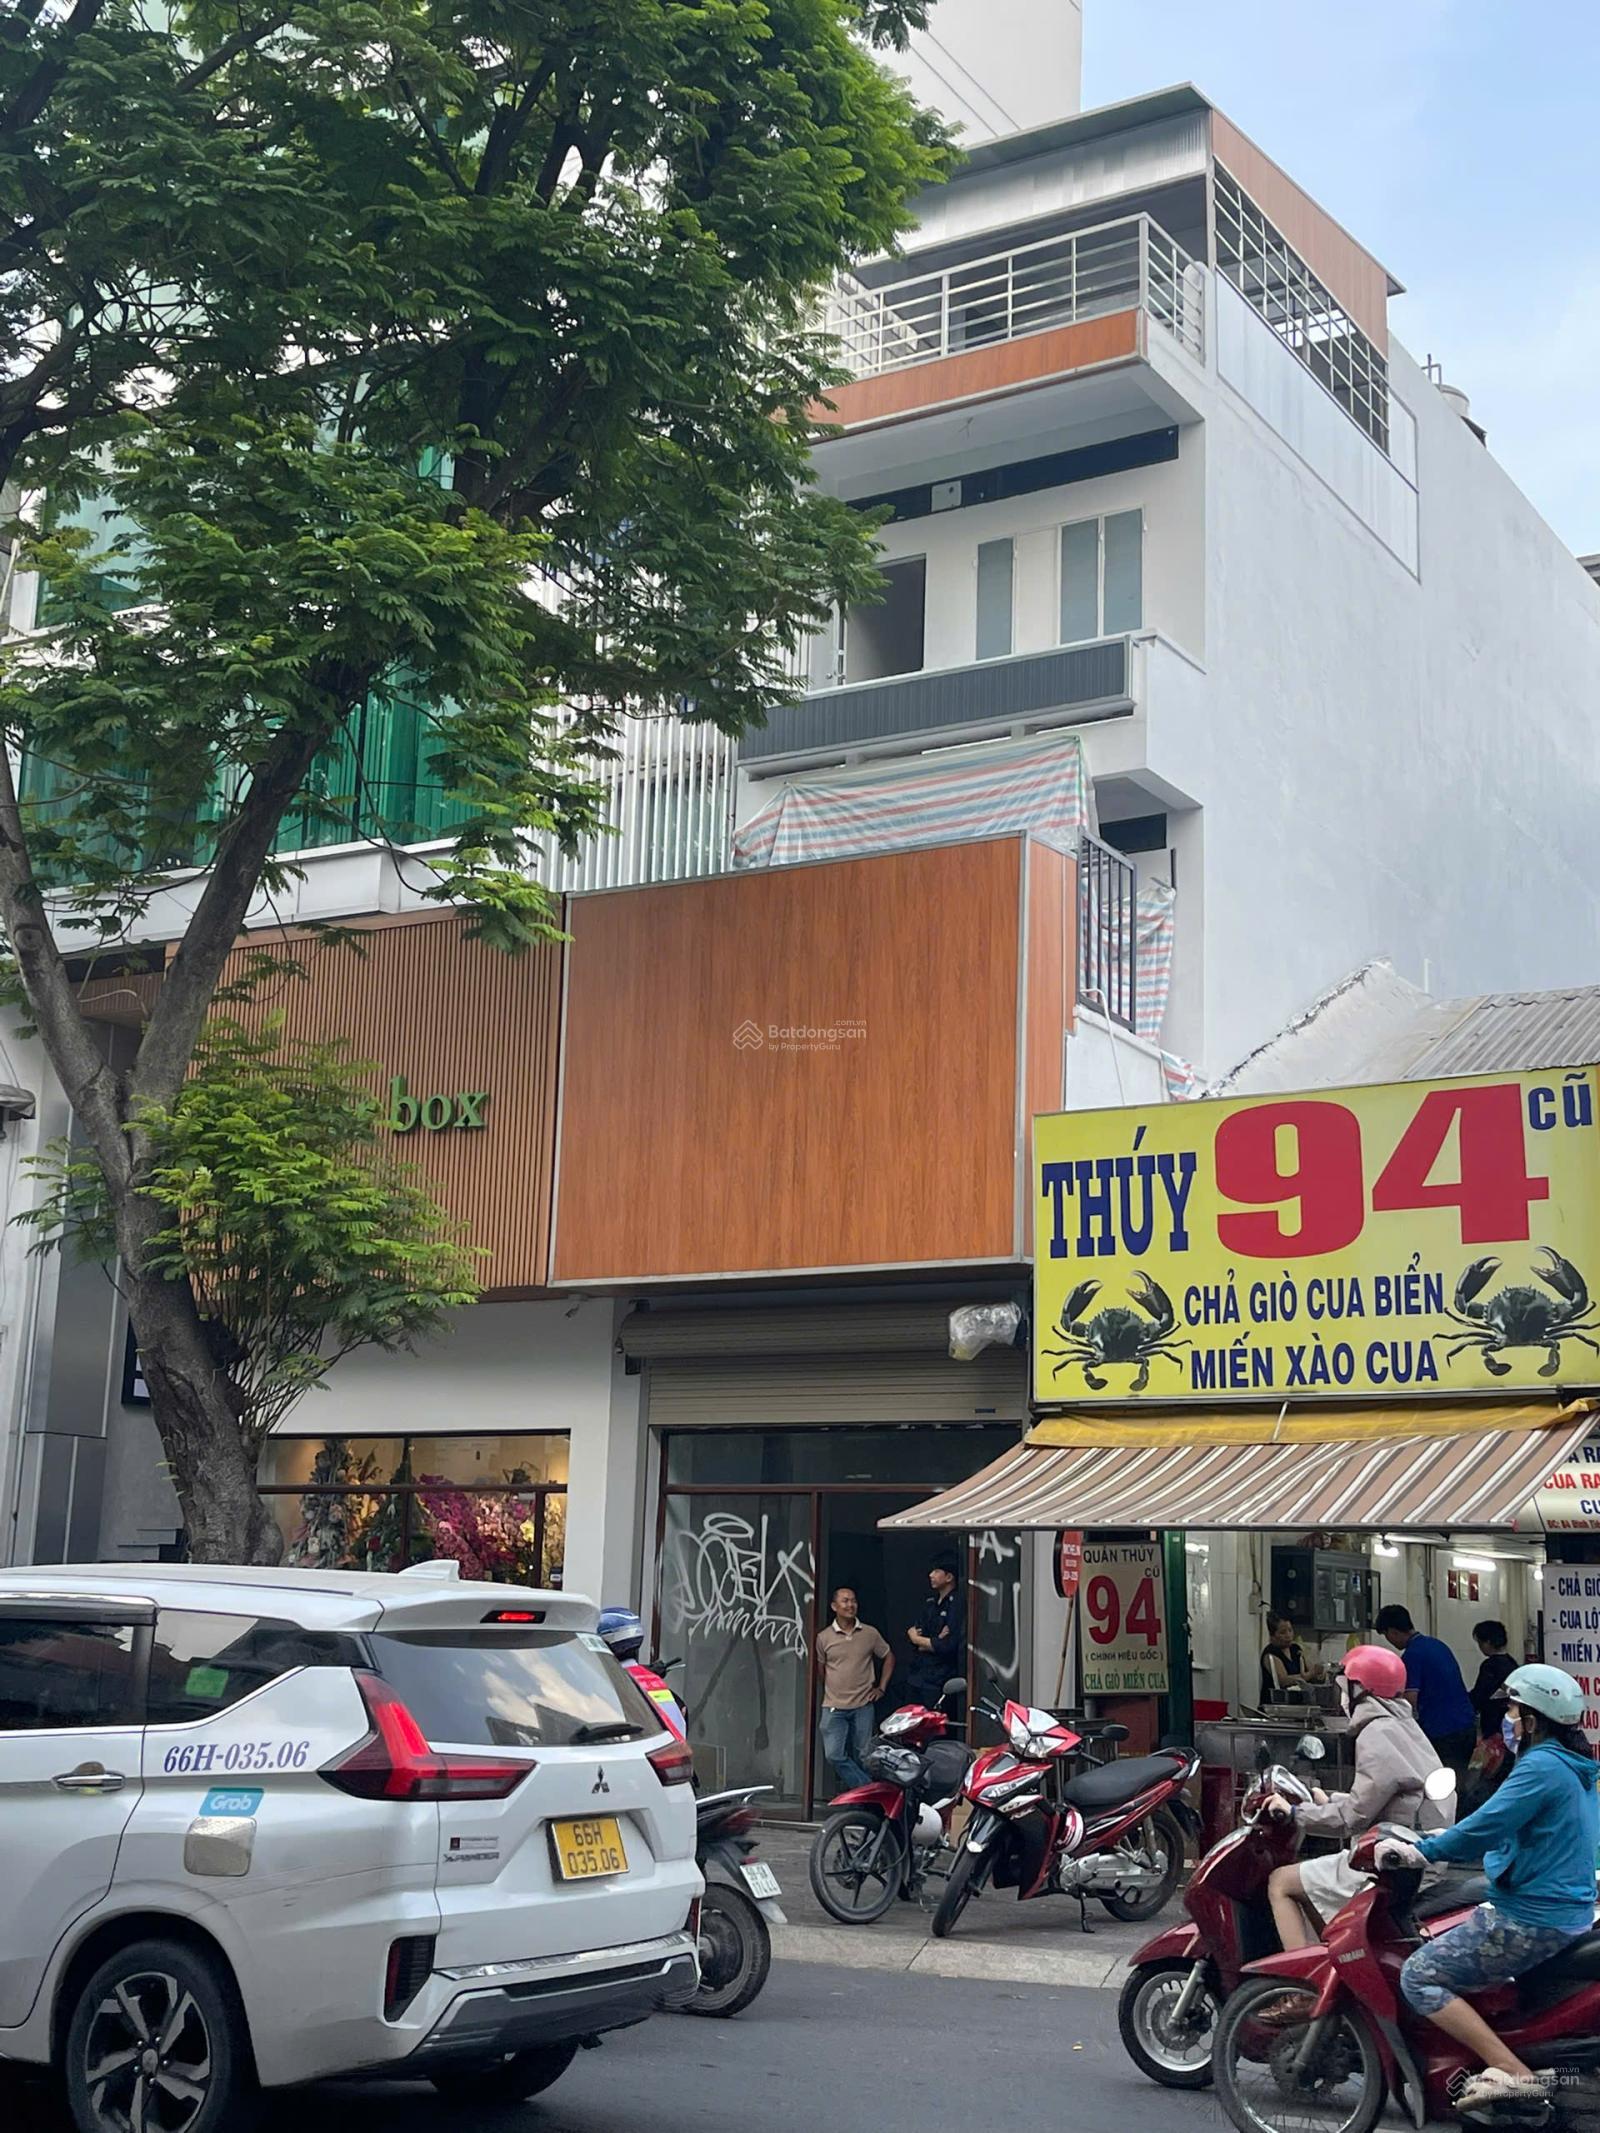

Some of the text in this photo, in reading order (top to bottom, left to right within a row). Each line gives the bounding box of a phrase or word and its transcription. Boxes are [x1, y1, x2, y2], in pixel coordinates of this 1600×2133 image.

[389, 1073, 488, 1132] box
[1042, 1126, 1197, 1259] THÚY
[1215, 1083, 1550, 1260] 94
[1184, 1252, 1445, 1326] CHẢ GIÒ CUA BIỂN
[1191, 1331, 1439, 1390] MIẾN XÀO CUA
[1083, 1545, 1120, 1563] QUÁN
[1558, 1571, 1582, 1597] CHẢ
[1086, 1574, 1162, 1647] 94
[1560, 1606, 1600, 1634] CUA LỘ
[1561, 1637, 1593, 1663] MIẾN
[1084, 1668, 1103, 1690] CHẢ
[1105, 1668, 1120, 1690] GIÒ
[1148, 1672, 1166, 1689] CUA
[164, 1741, 310, 1773] 66H-035.06
[210, 1794, 252, 1811] Grab
[573, 1822, 603, 1847] 66H
[567, 1847, 620, 1875] 035.06
